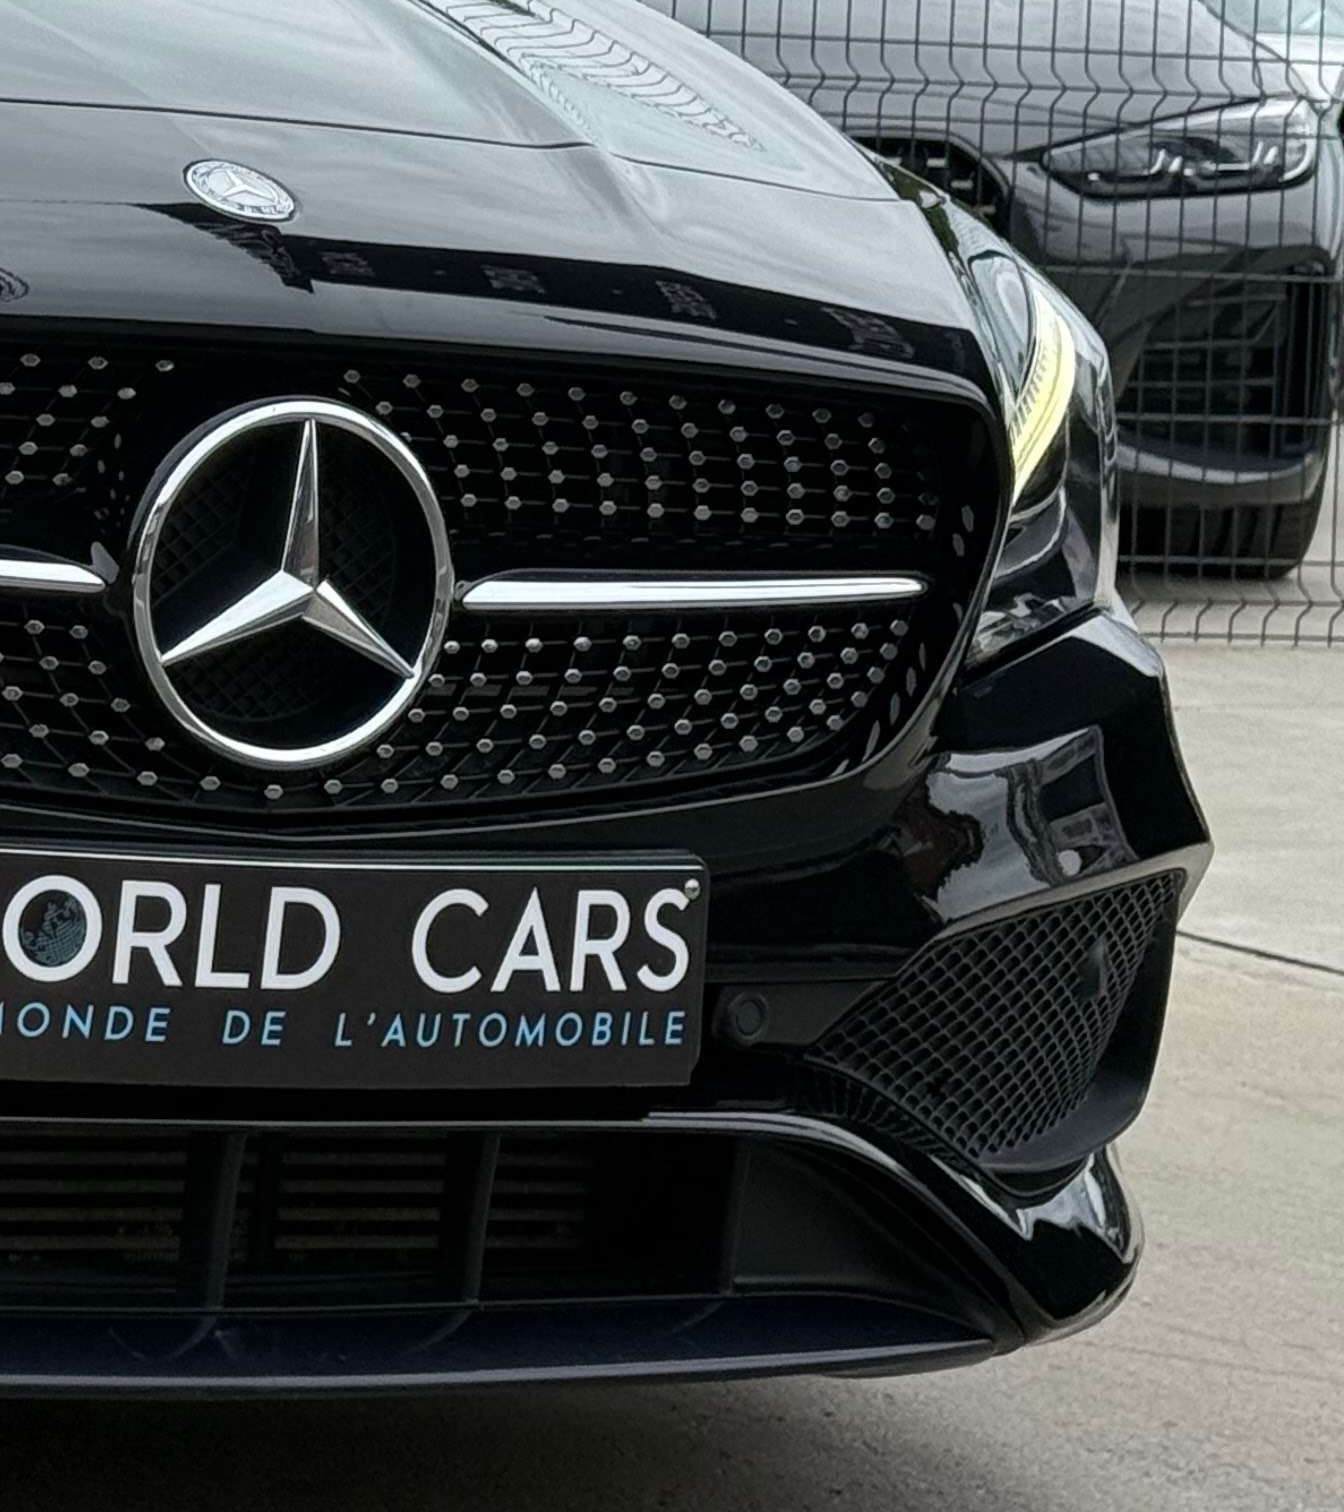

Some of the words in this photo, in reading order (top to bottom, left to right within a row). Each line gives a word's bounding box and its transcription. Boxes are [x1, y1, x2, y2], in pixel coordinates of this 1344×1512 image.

[411, 887, 690, 993] CARS
[222, 1010, 286, 1046] DE
[335, 1010, 685, 1048] L'AUTOMOBILE
